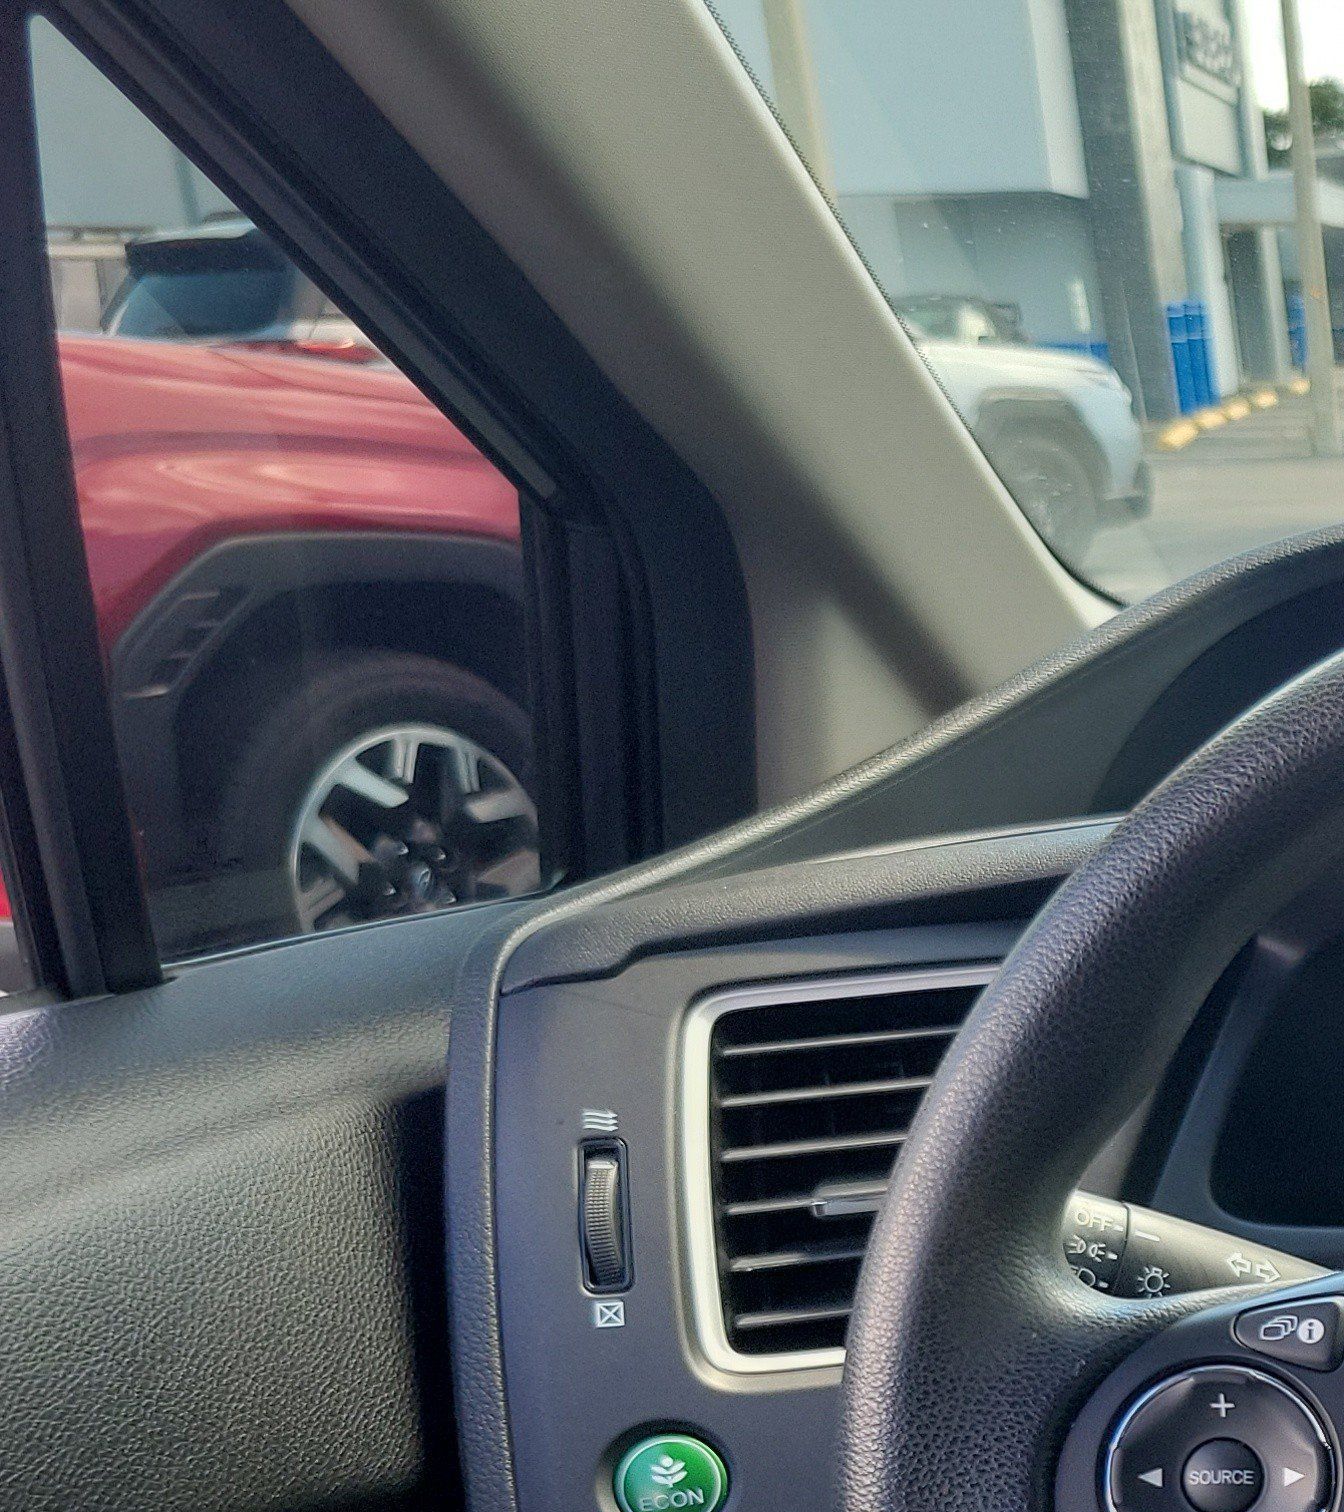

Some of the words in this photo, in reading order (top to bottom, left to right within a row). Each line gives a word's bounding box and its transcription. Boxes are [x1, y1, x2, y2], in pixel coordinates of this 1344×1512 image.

[1076, 1208, 1115, 1231] OFF
[1188, 1470, 1255, 1486] SOURCE
[638, 1487, 705, 1512] ECON
